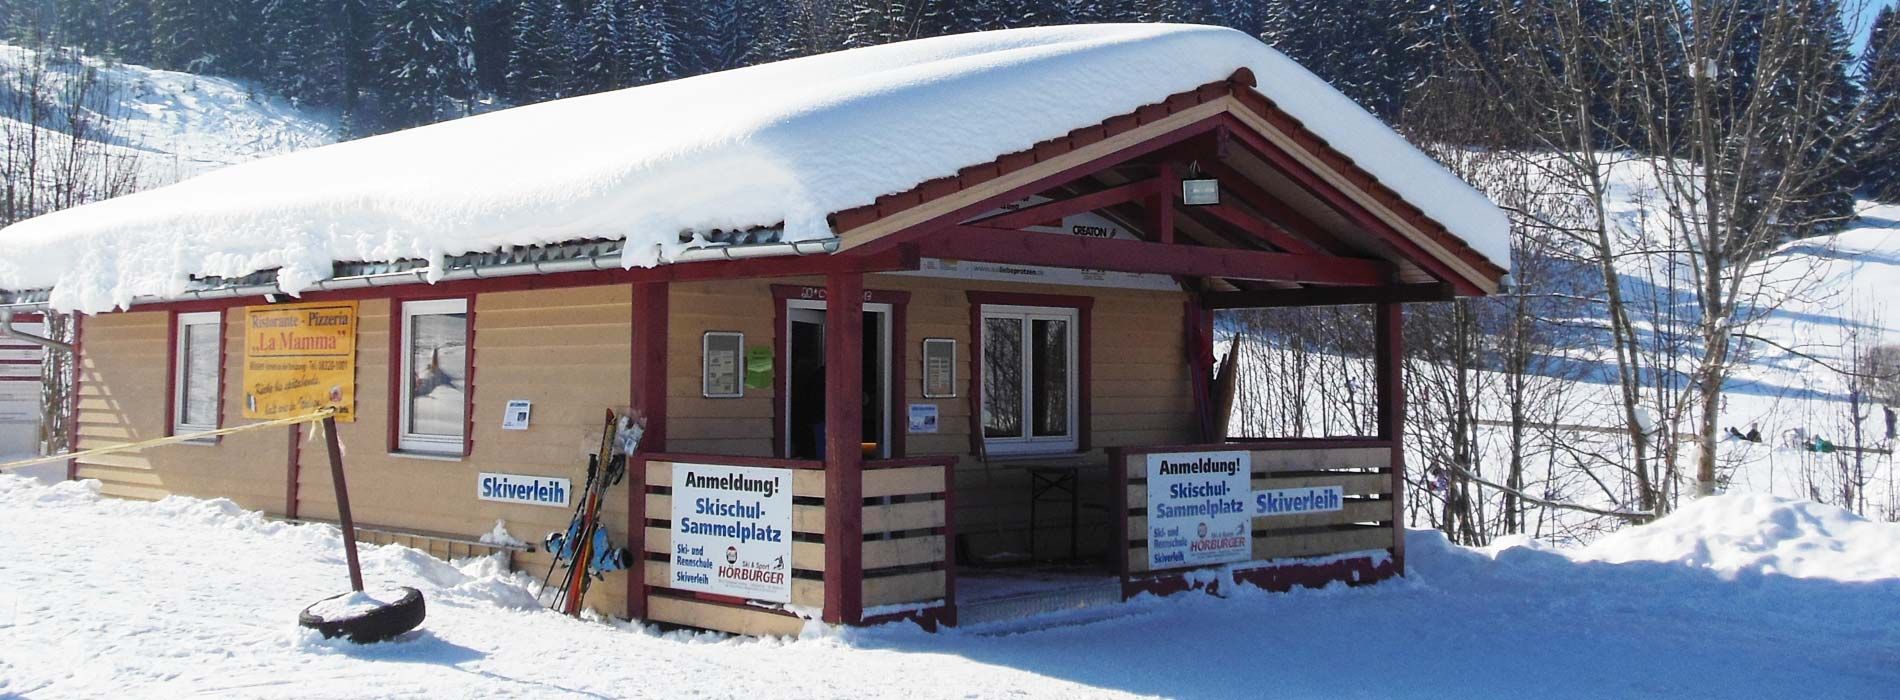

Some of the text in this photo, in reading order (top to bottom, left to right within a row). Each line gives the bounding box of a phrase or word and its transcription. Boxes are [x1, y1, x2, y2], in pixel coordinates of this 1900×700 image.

[1072, 225, 1107, 237] CREATON
[252, 314, 299, 329] Ristorante
[308, 311, 348, 327] Pizzeria
[1159, 458, 1240, 476] Anmeldung!
[482, 477, 564, 503] Skiverleih
[685, 471, 779, 498] Anmeldung!
[1170, 480, 1231, 499] Skischul-
[695, 498, 766, 519] Skischul-
[1156, 498, 1244, 519] Sammelplatz
[1256, 488, 1339, 514] Skiverleih
[681, 517, 782, 543] Sammelplatz
[677, 544, 704, 556] Ski- und
[676, 556, 713, 569] Rennschule
[742, 560, 750, 568] Ski
[756, 562, 770, 572] Sport
[676, 571, 709, 585] Skiverleih
[718, 564, 784, 585] HÖRBURGER
